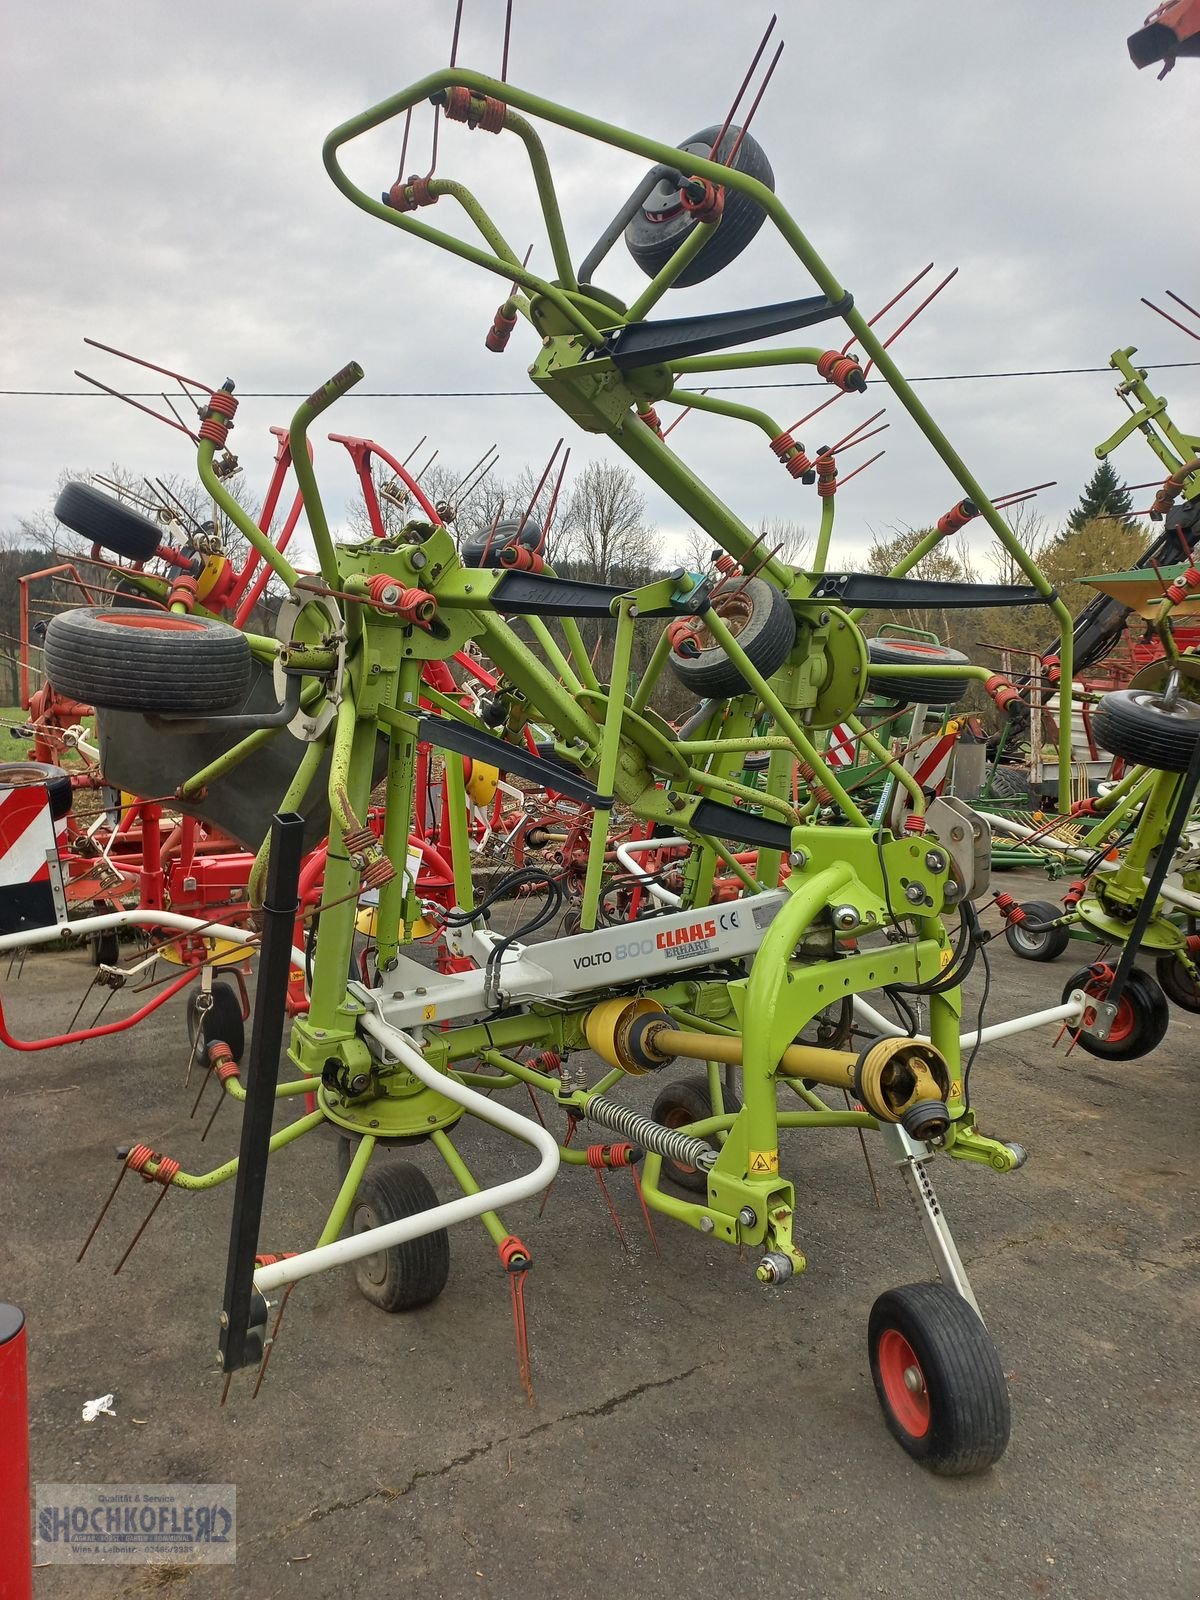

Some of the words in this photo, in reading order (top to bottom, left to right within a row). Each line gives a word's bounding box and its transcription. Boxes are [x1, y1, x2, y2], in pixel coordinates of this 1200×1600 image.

[656, 920, 717, 949] CLAAS
[664, 939, 711, 959] ERHART
[573, 951, 612, 969] VOLTO
[614, 939, 654, 961] 800
